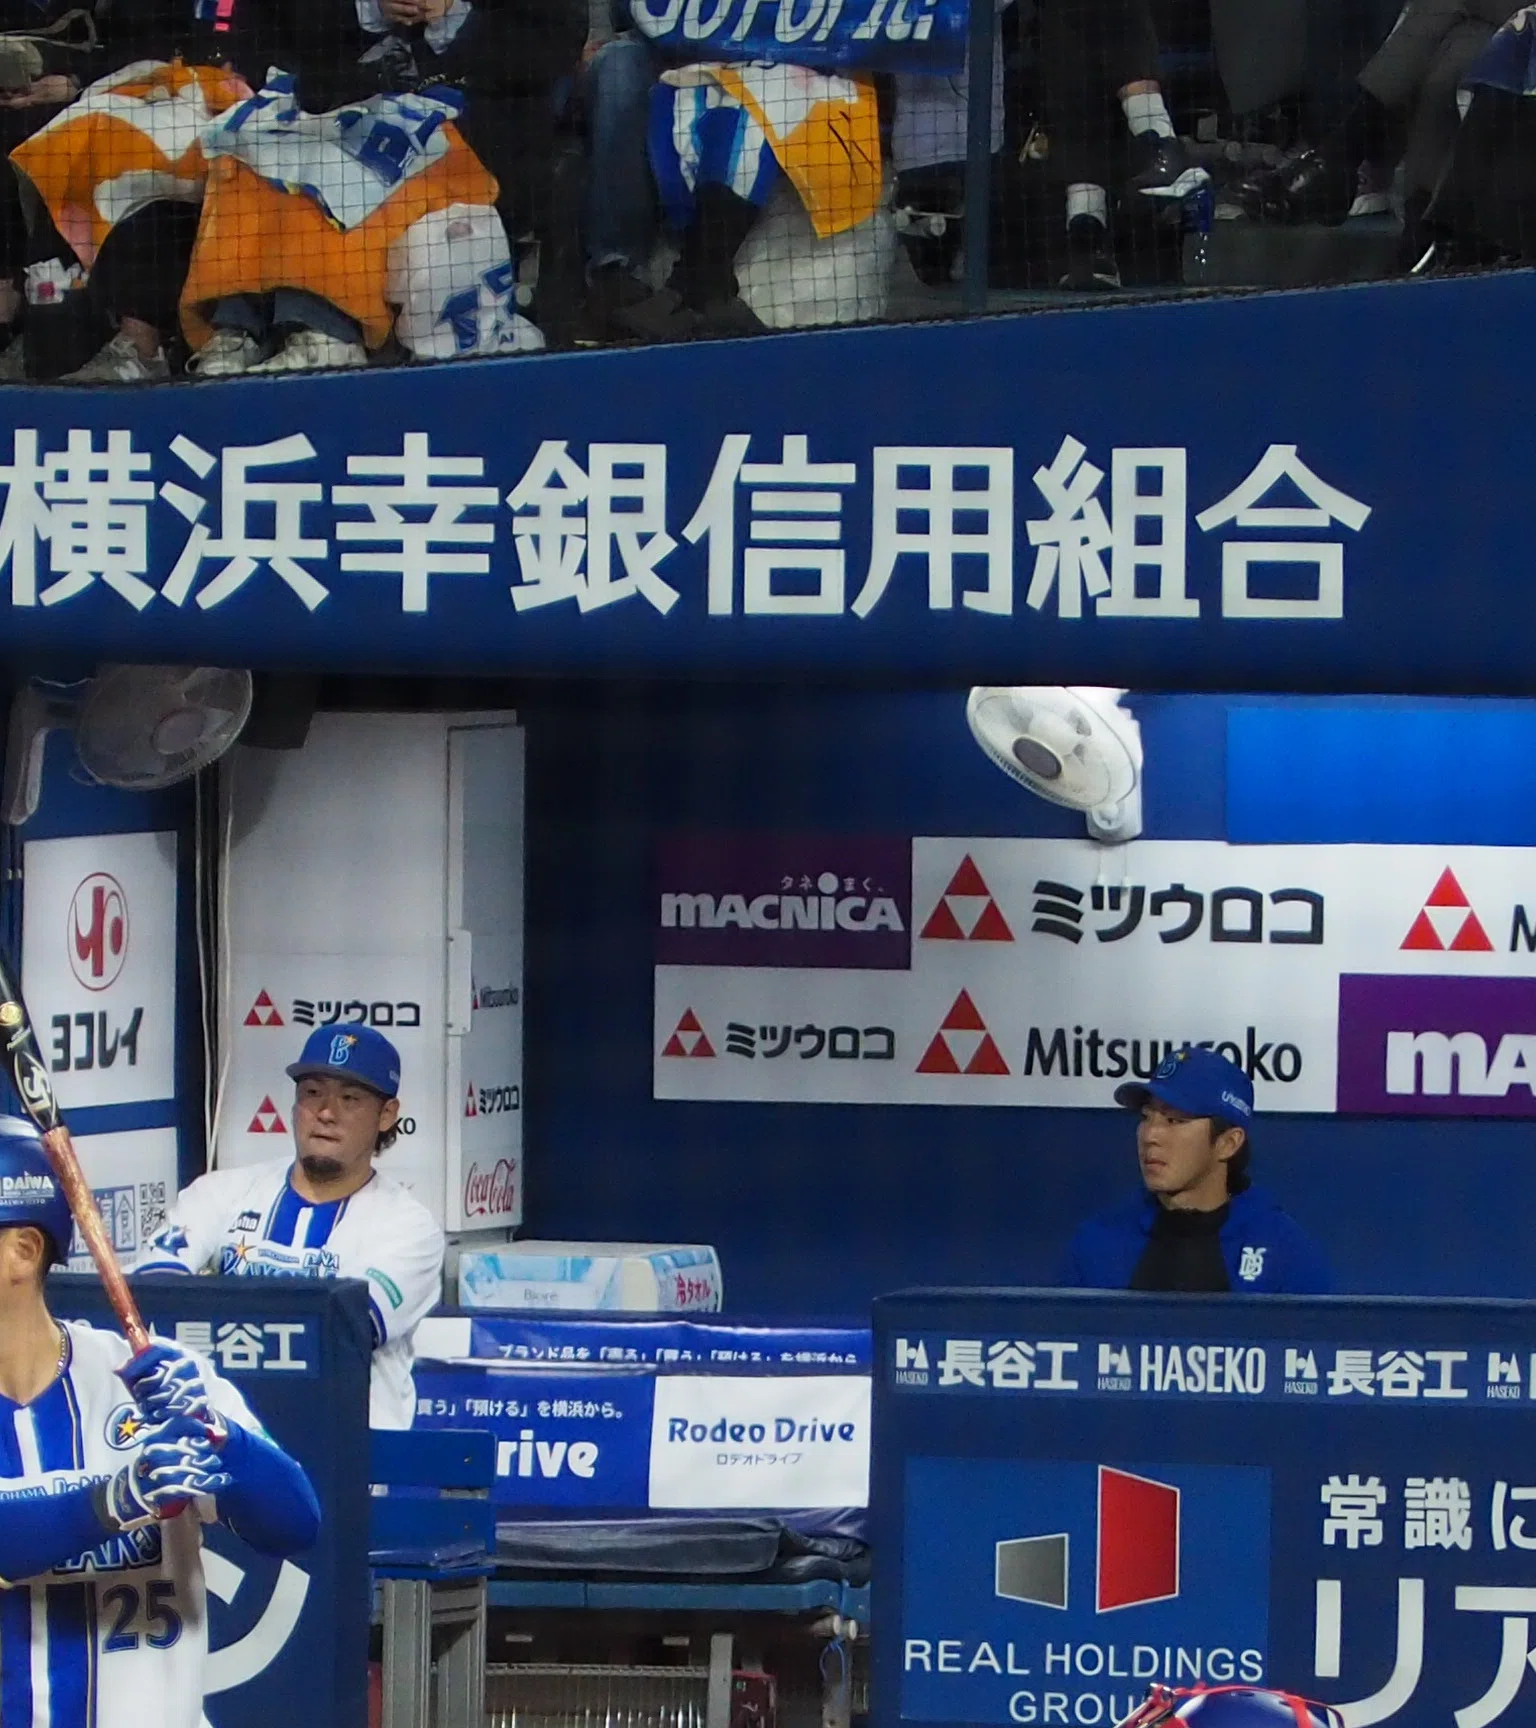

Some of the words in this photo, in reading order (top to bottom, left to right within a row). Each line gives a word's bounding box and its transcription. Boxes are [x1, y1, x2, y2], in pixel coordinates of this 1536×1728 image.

[1031, 880, 1323, 944] ミツウロコ
[293, 1000, 420, 1028] ミツウロコ
[52, 1007, 143, 1072] ヨコレイ
[726, 1023, 894, 1060] ミツウロコ
[938, 1340, 1078, 1389] 長谷工
[1140, 1345, 1265, 1394] HASEKO
[1327, 1351, 1467, 1398] 長谷工
[497, 1430, 598, 1478] rive
[669, 1418, 765, 1443] Rodeo
[775, 1418, 855, 1443] Drive
[101, 1582, 184, 1656] 25
[905, 1640, 1029, 1675] REAL
[1046, 1643, 1263, 1682] HOLDINGS
[1010, 1691, 1144, 1726] GROU
